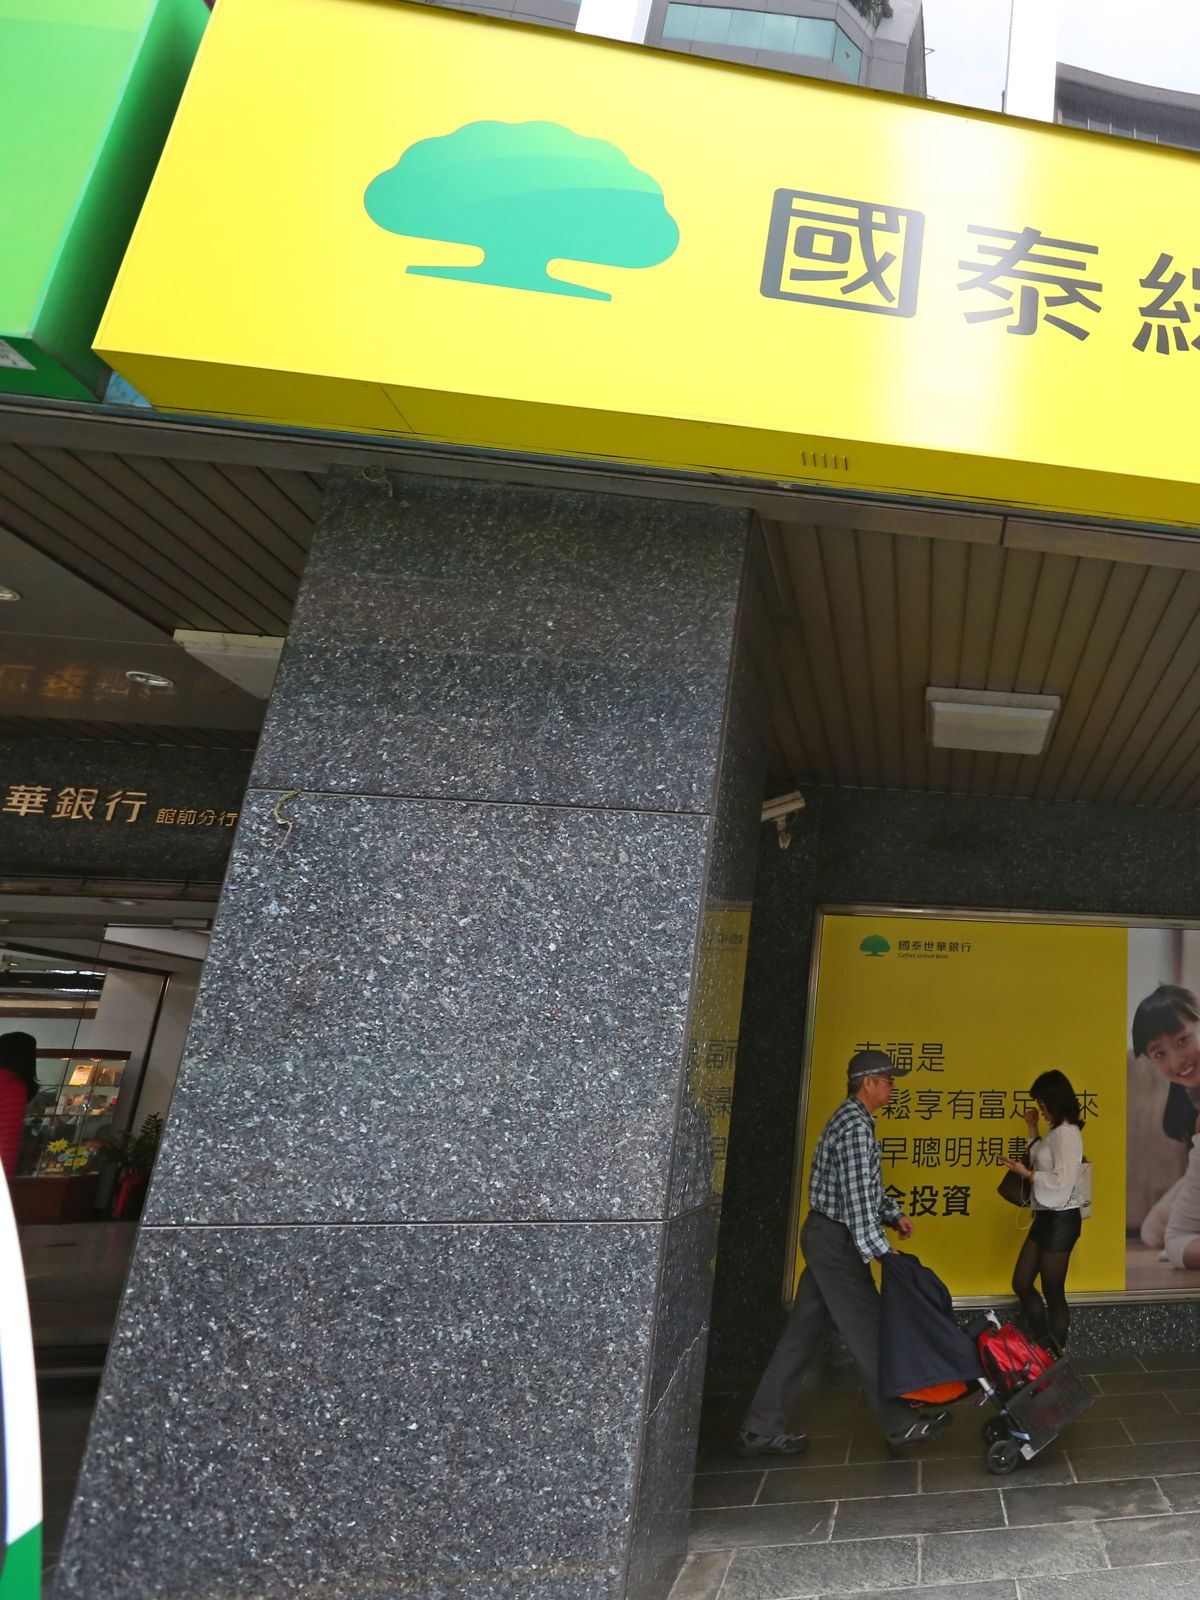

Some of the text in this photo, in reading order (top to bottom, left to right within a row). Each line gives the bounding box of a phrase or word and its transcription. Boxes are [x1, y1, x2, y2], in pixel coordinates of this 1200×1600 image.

[2, 784, 239, 827] 華銀行 館前分行
[897, 939, 972, 953] 國泰世華銀行
